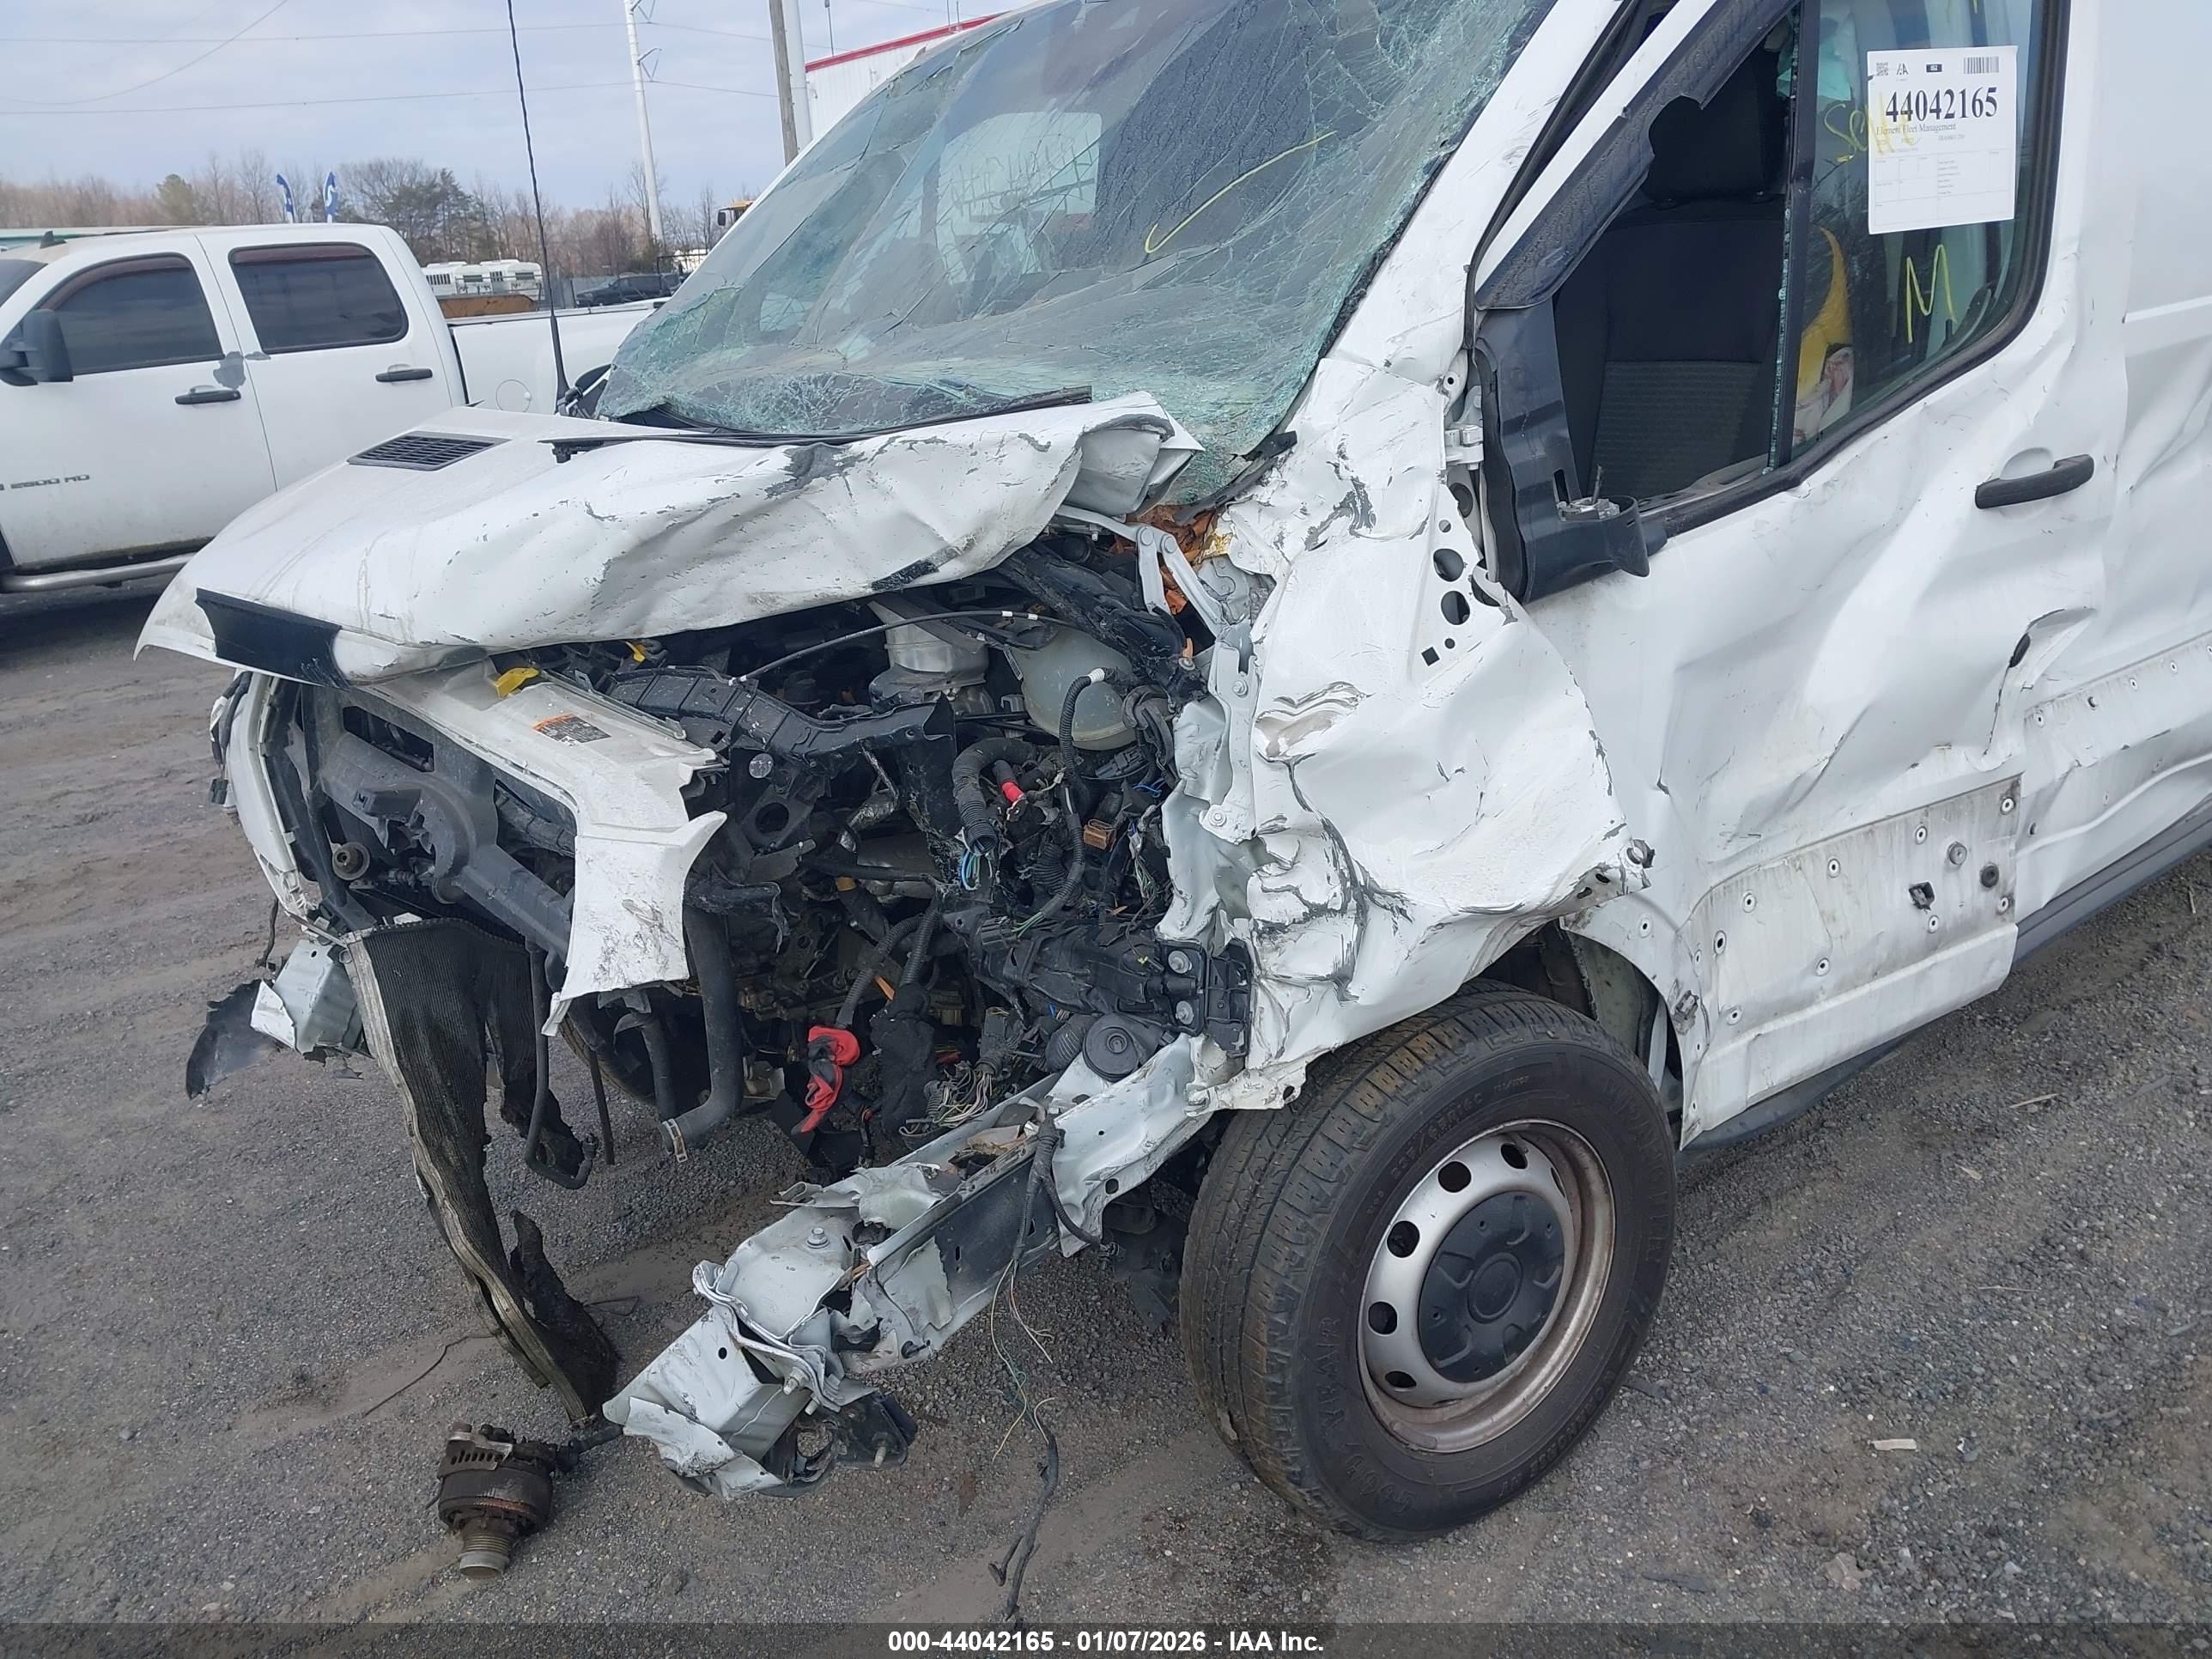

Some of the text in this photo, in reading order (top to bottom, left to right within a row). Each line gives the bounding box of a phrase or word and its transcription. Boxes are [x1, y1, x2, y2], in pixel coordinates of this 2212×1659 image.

[1886, 87, 1997, 122] 44042165
[1902, 124, 1917, 134] Fleet
[1919, 123, 1956, 134] Management
[1905, 244, 1958, 343] M
[11, 478, 60, 489] 2500
